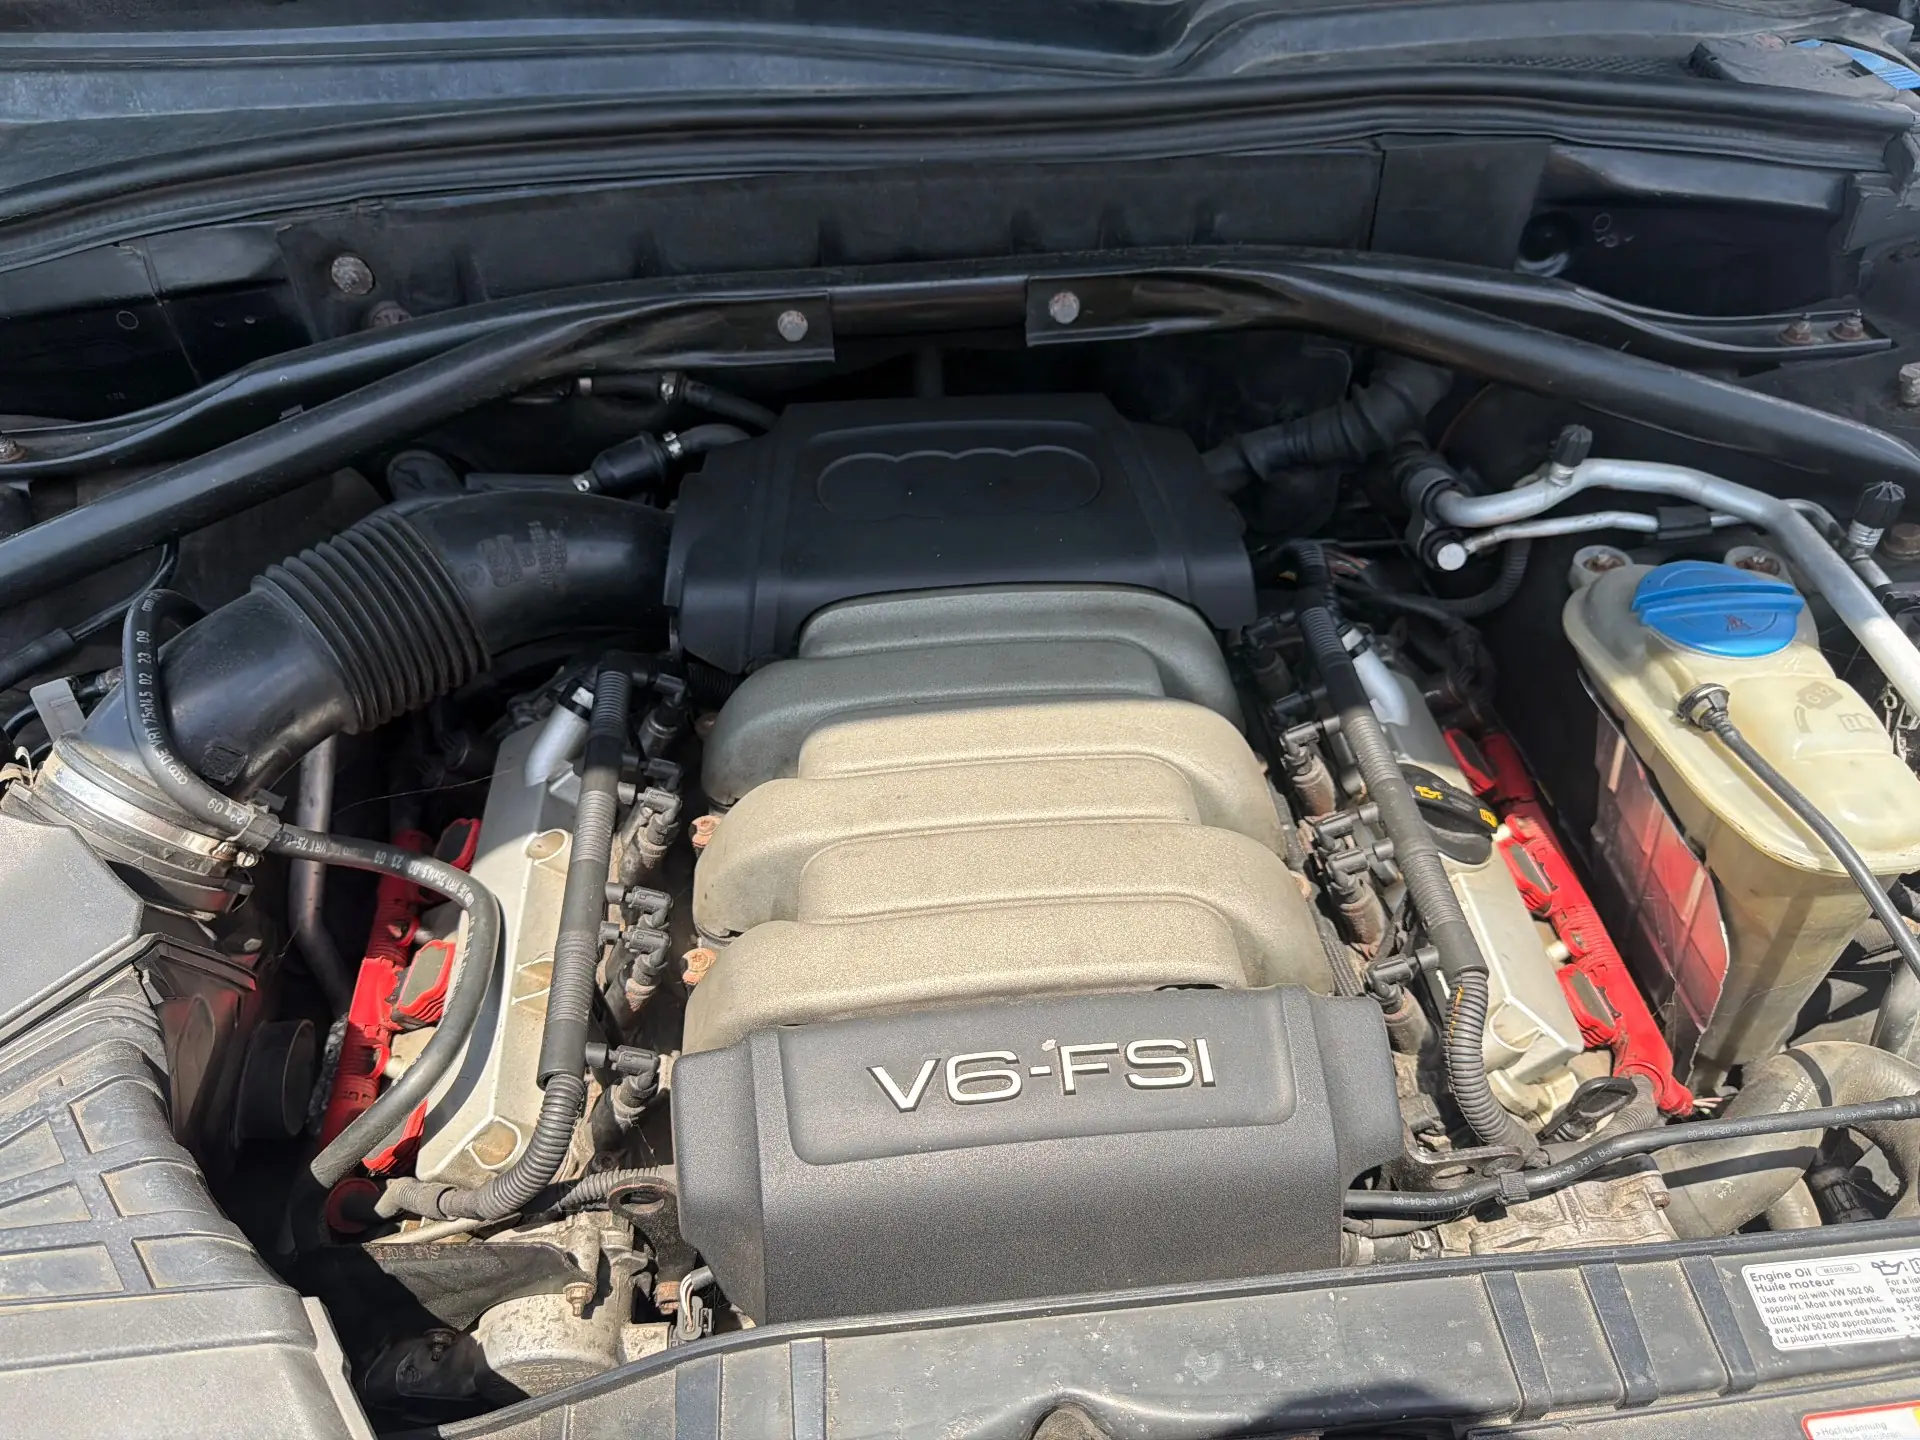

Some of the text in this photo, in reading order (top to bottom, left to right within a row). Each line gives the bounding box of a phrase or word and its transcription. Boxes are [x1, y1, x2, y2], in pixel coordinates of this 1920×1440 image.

[136, 630, 150, 643] 09
[137, 652, 151, 664] 23
[139, 672, 152, 685] 02
[1750, 1271, 1792, 1282] Engine
[1795, 1268, 1812, 1277] Oil
[1754, 1279, 1835, 1292] Huile moteur
[1885, 1278, 1900, 1286] For
[1760, 1285, 1875, 1304] Use only oil with VW 502 00
[1889, 1287, 1910, 1296] Pour
[1765, 1303, 1804, 1314] approval.
[1804, 1300, 1827, 1309] Most
[1844, 1295, 1883, 1306] synthetic.
[1768, 1304, 1897, 1325] Utilisez uniquement des huiles
[1794, 1323, 1810, 1332] VW
[1811, 1321, 1828, 1331] 502
[1828, 1320, 1840, 1329] 00
[1841, 1316, 1896, 1328] approbation.
[1776, 1326, 1900, 1344] La plupart sont synthétiques.
